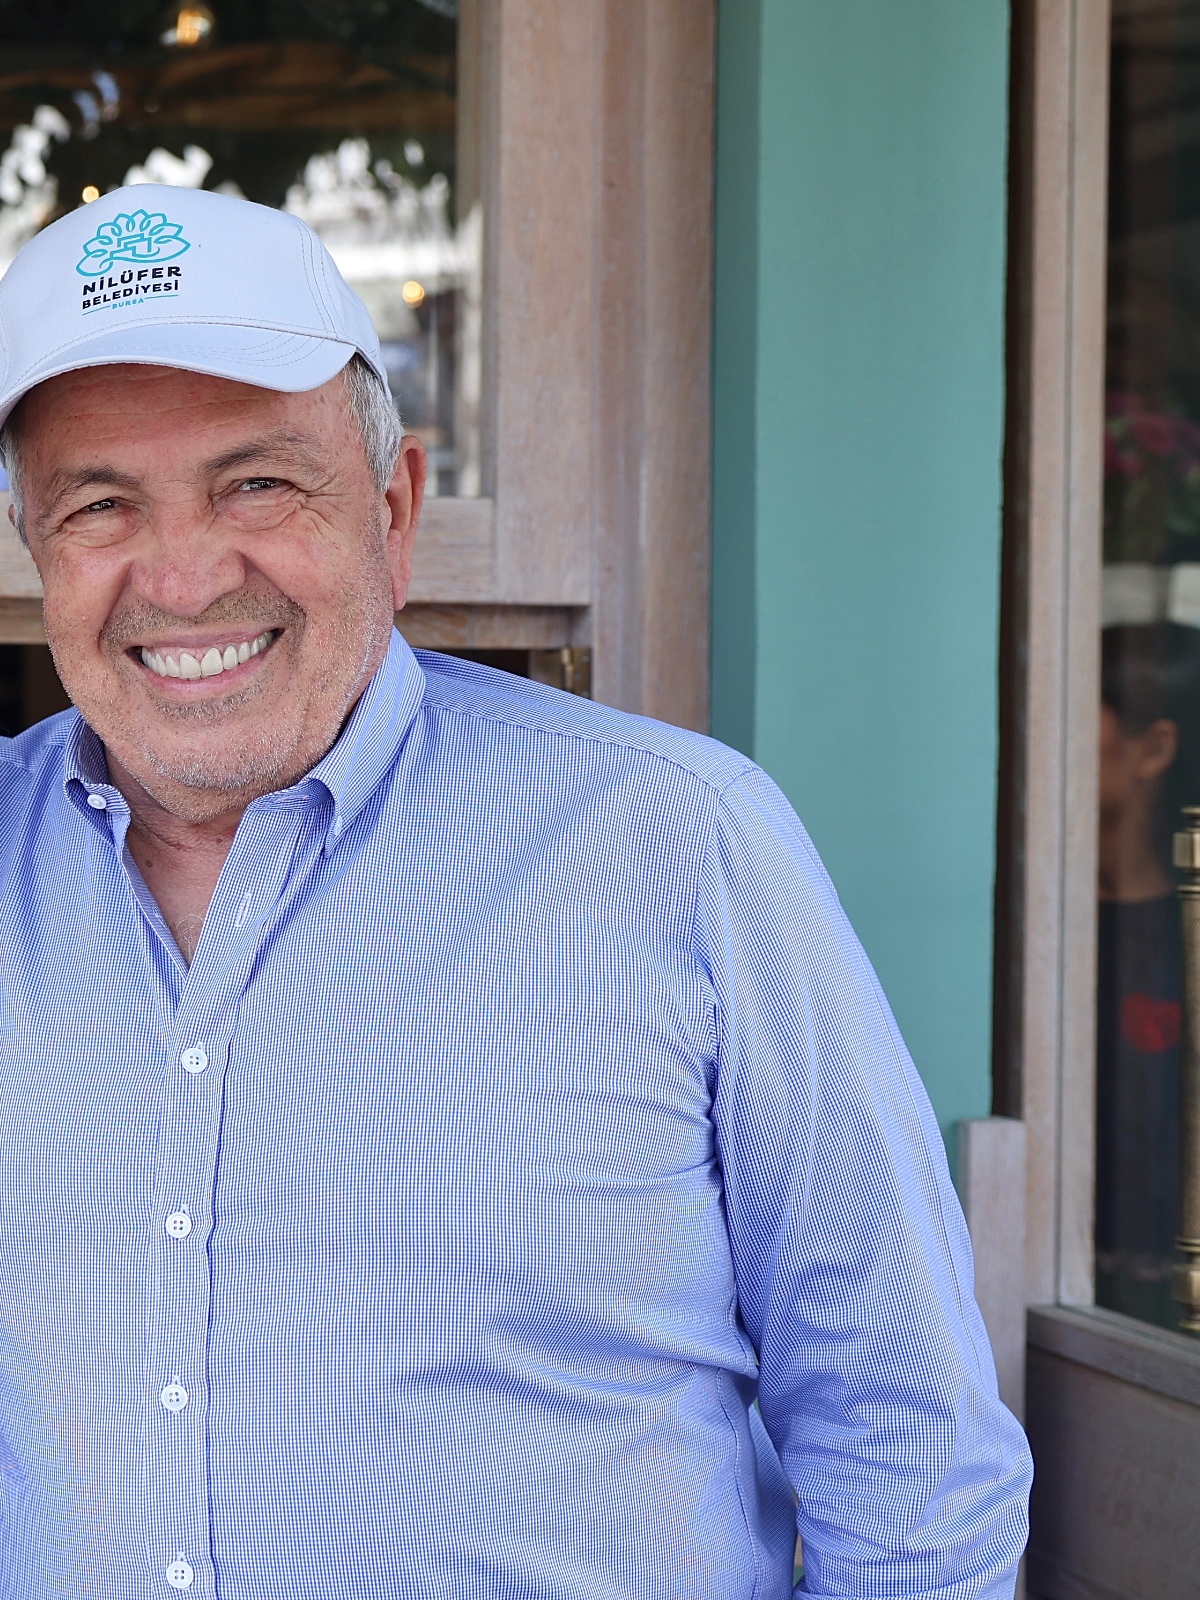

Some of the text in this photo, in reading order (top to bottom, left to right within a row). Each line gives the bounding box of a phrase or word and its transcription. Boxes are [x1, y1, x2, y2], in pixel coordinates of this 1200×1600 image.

[82, 266, 182, 296] NİLÜFER
[82, 279, 179, 310] BELEDİYESİ
[112, 298, 145, 309] BURSA
